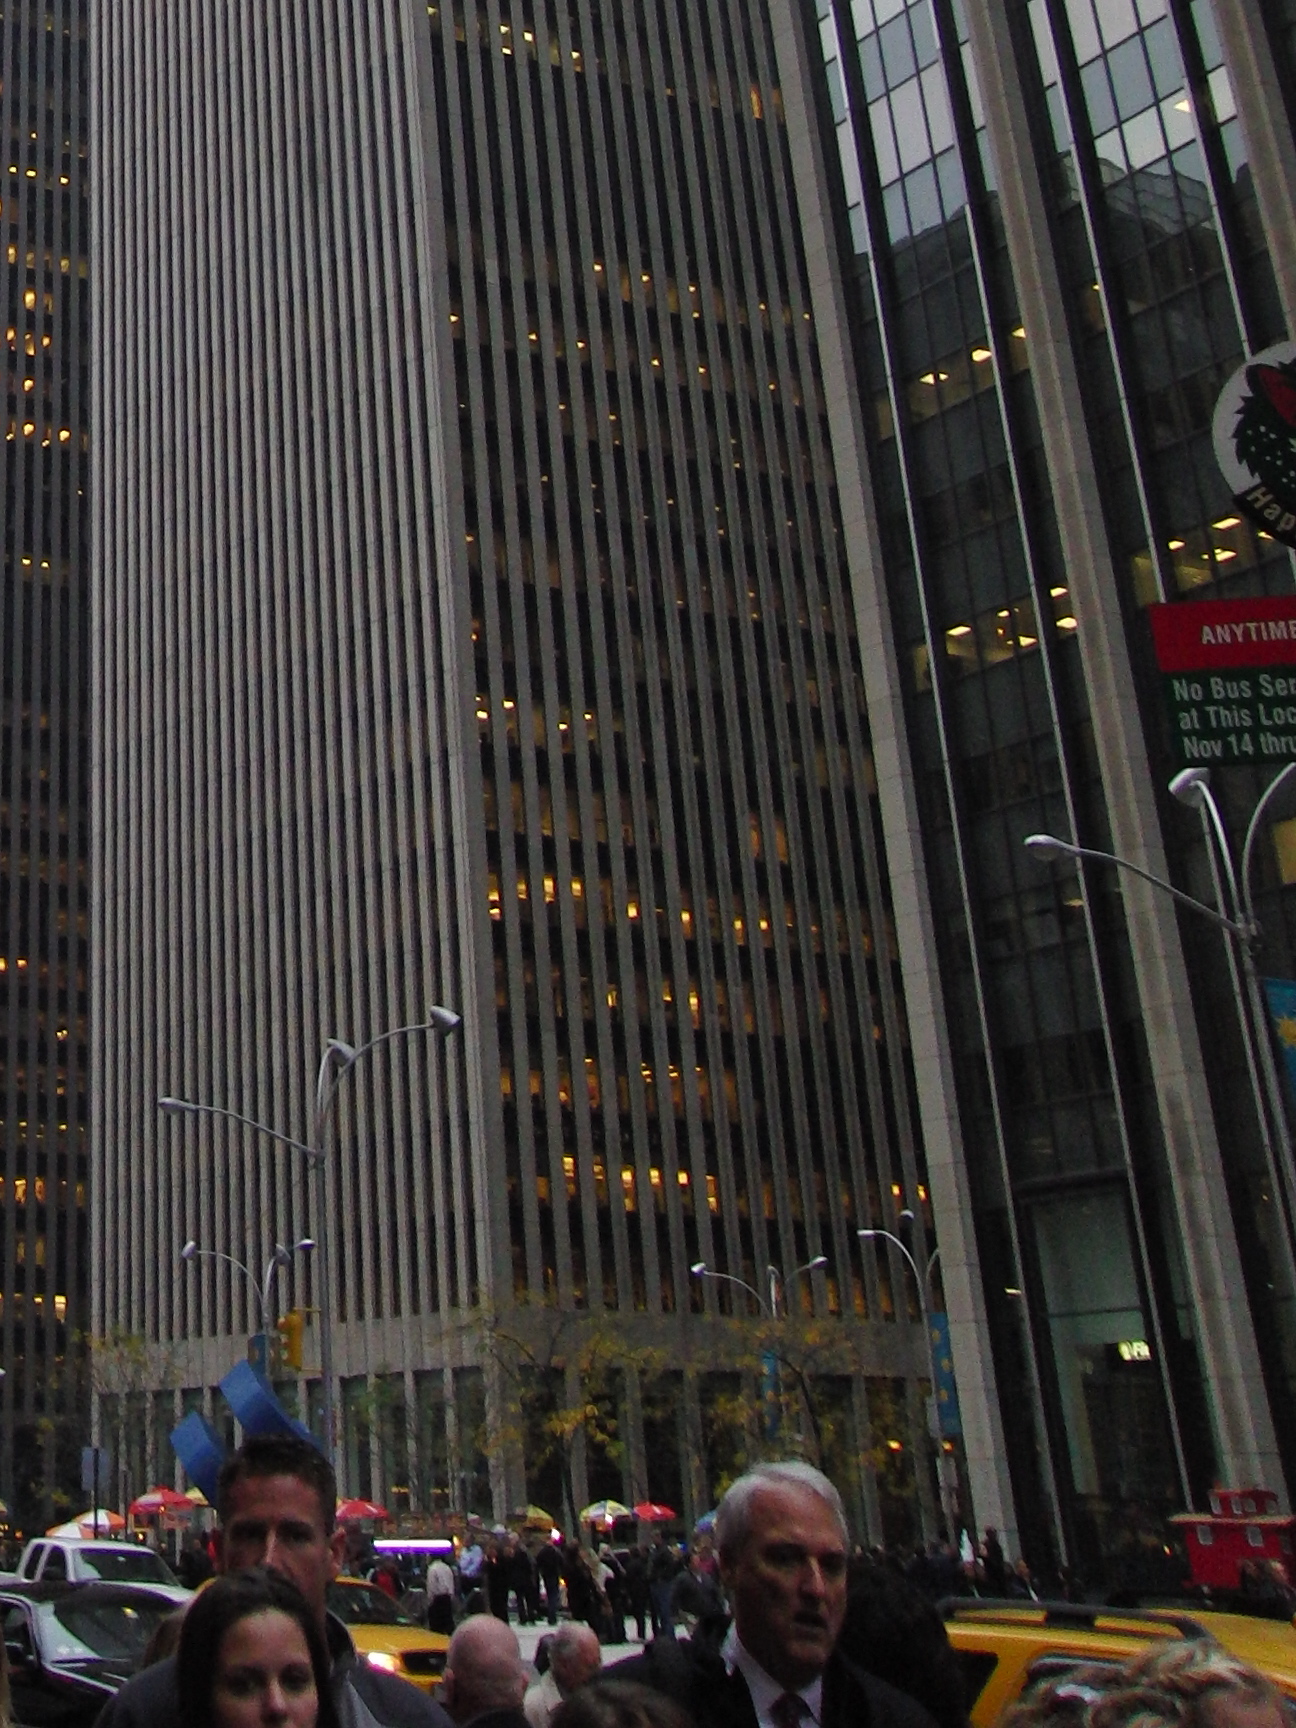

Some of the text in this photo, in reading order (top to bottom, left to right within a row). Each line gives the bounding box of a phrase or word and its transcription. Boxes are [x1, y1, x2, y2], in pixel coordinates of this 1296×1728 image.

[1172, 678, 1203, 701] No
[1210, 677, 1252, 700] Bus
[1179, 707, 1200, 730] at
[1205, 705, 1253, 728] This
[1182, 736, 1222, 759] Nov
[1227, 732, 1254, 756] 14
